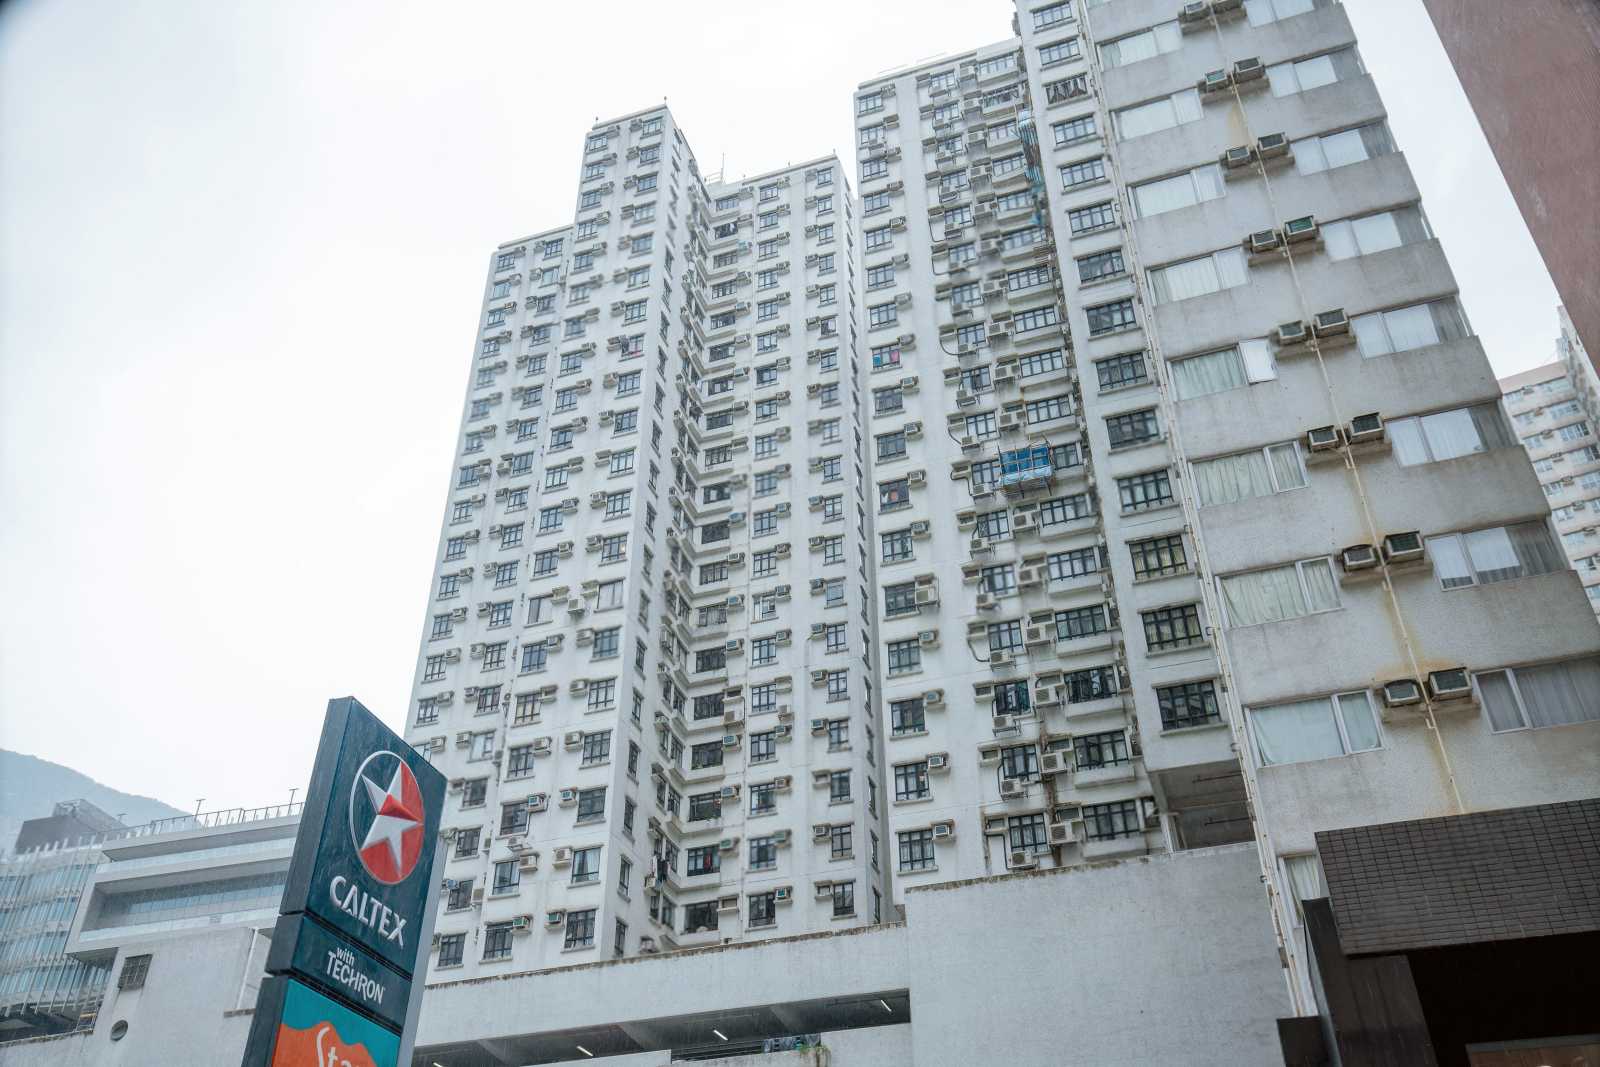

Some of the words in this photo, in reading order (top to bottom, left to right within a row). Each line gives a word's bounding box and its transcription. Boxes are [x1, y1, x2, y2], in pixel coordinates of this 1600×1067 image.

[330, 876, 407, 949] CALTEX
[327, 951, 383, 1004] TECHRON
[336, 947, 355, 966] with
